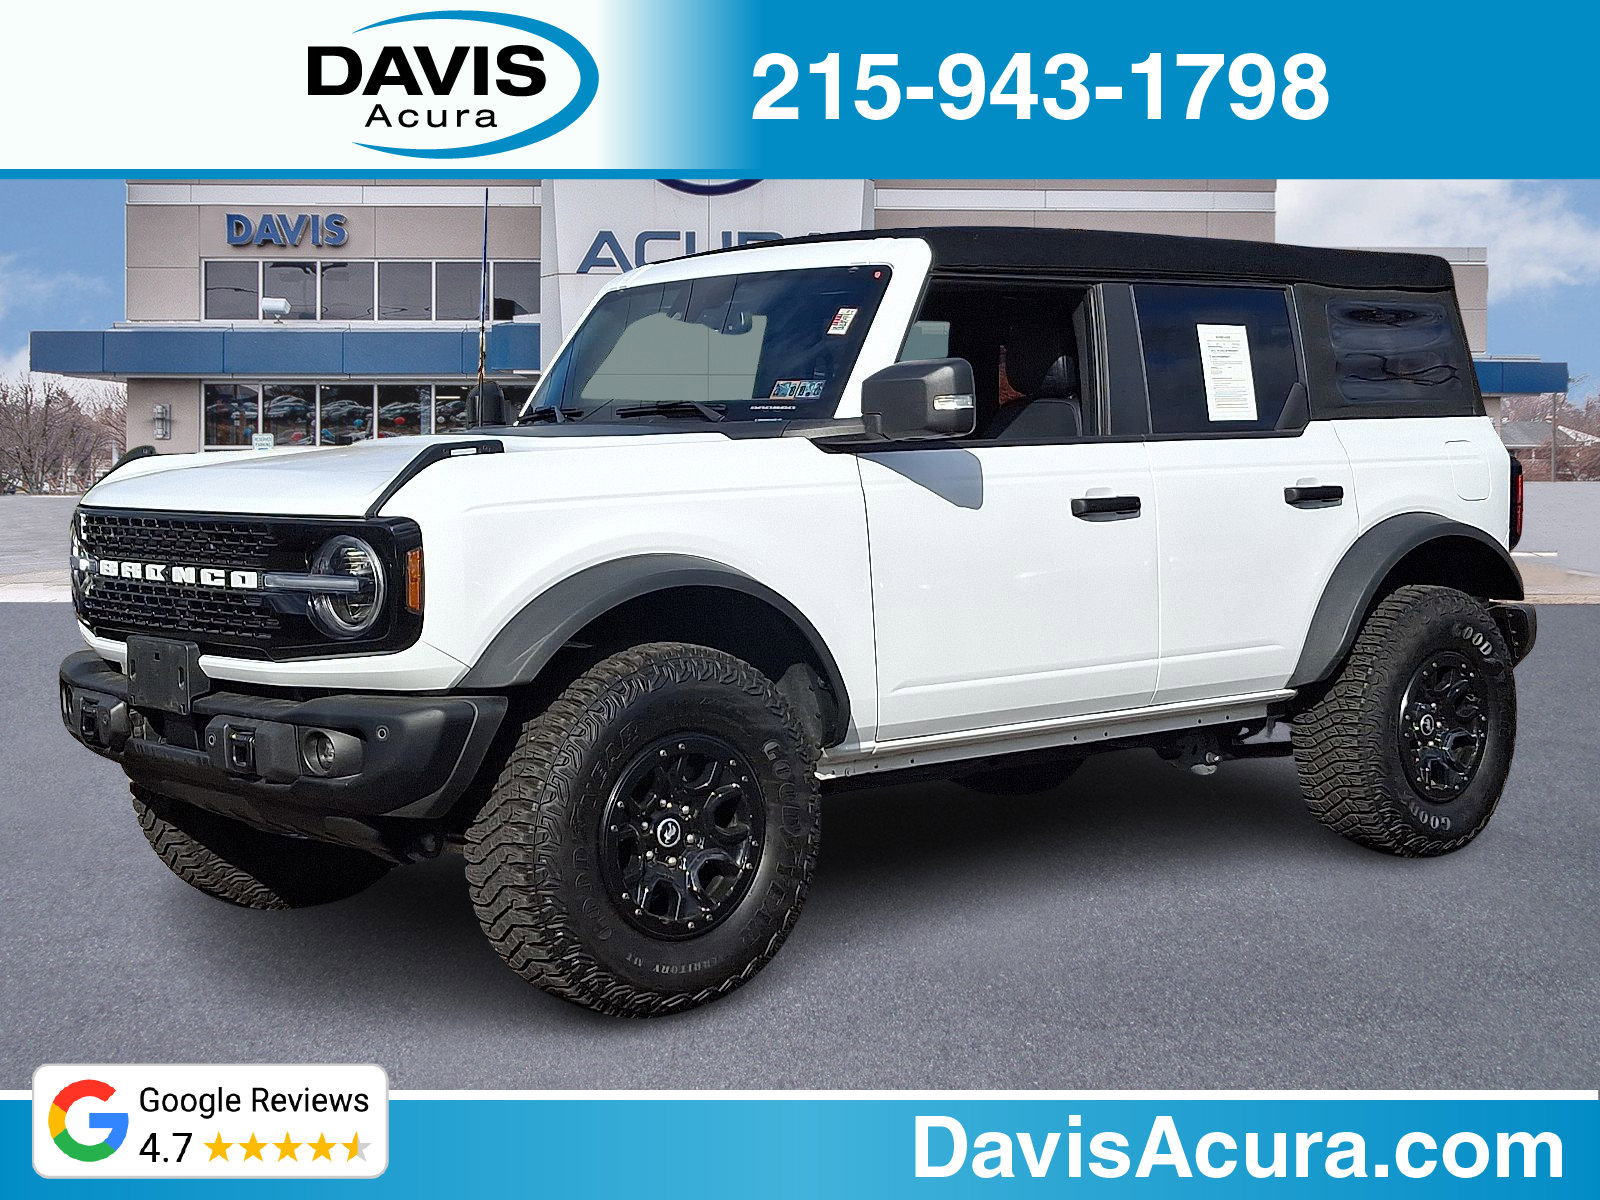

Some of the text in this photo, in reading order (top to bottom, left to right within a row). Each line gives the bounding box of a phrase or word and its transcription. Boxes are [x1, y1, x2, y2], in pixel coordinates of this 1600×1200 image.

[226, 213, 348, 246] DAVIS
[576, 230, 822, 274] ACU
[99, 559, 258, 589] BRONCO
